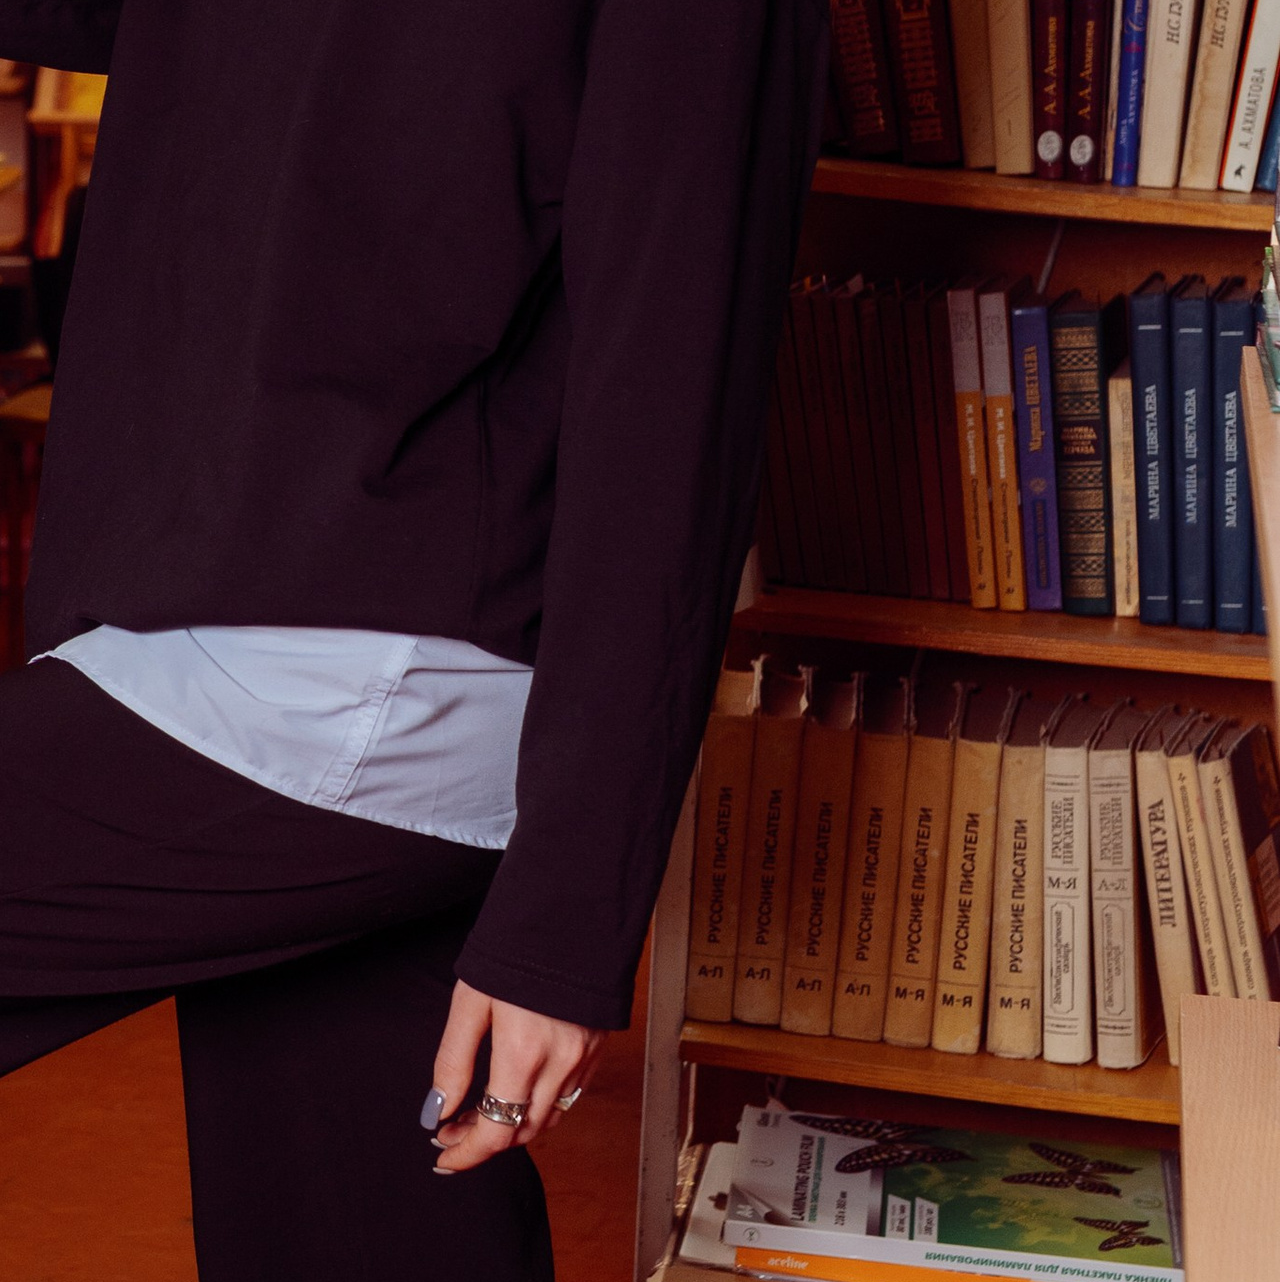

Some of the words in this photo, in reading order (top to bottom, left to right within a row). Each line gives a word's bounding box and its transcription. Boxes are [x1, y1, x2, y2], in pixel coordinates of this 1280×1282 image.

[1241, 66, 1266, 134] АХМАТОВА
[1144, 384, 1160, 455] ЦВЕТАЕВА
[1183, 387, 1198, 459] ЦВЕТАЕВА
[1223, 391, 1237, 462] ЦВЕТАЕВА
[1147, 460, 1160, 520] МАРИНА
[1184, 463, 1198, 524] МАРИНА
[1224, 467, 1237, 527] МАРИНА
[712, 787, 733, 869] ПИСАТЕЛИ
[762, 789, 782, 870] ПИСАТЕЛИ
[813, 802, 833, 883] ПИСАТЕЛИ
[862, 807, 883, 888] ПИСАТЕЛИ
[912, 807, 932, 890] ПИСАТЕЛИ
[959, 813, 980, 895] ПИСАТЕЛИ
[1011, 819, 1028, 900] ПИСАТЕЛИ
[1050, 800, 1063, 859] РУССКИЕ
[1063, 797, 1074, 865] ПИСАТЕЛИ
[1099, 802, 1111, 861] РУССКИЕ
[1111, 797, 1123, 865] ПИСАТЕЛИ
[1047, 877, 1077, 889] М-Я
[1146, 798, 1177, 928] ЛИТЕРАТУРА
[707, 873, 727, 943] РУССКИЕ
[755, 875, 775, 945] РУССКИЕ
[806, 886, 825, 957] РУССКИЕ
[855, 892, 875, 961] РУССКИЕ
[906, 893, 925, 964] РУССКИЕ
[953, 899, 972, 971] РУССКИЕ
[1008, 904, 1026, 974] РУССКИЕ
[698, 965, 723, 978] А-Л
[745, 967, 770, 980] А-Л
[795, 978, 821, 991] А-Л
[845, 983, 871, 996] А-Л
[895, 987, 925, 1001] М-Я
[942, 993, 972, 1007] М-Я
[1000, 997, 1030, 1009] М-Я
[767, 1256, 809, 1271] aceline
[925, 1252, 1032, 1272] ЛАМИНИРОВАНИЯ
[1034, 1263, 1059, 1276] ДЛЯ
[1061, 1262, 1122, 1281] ПАКЕТНАЯ
